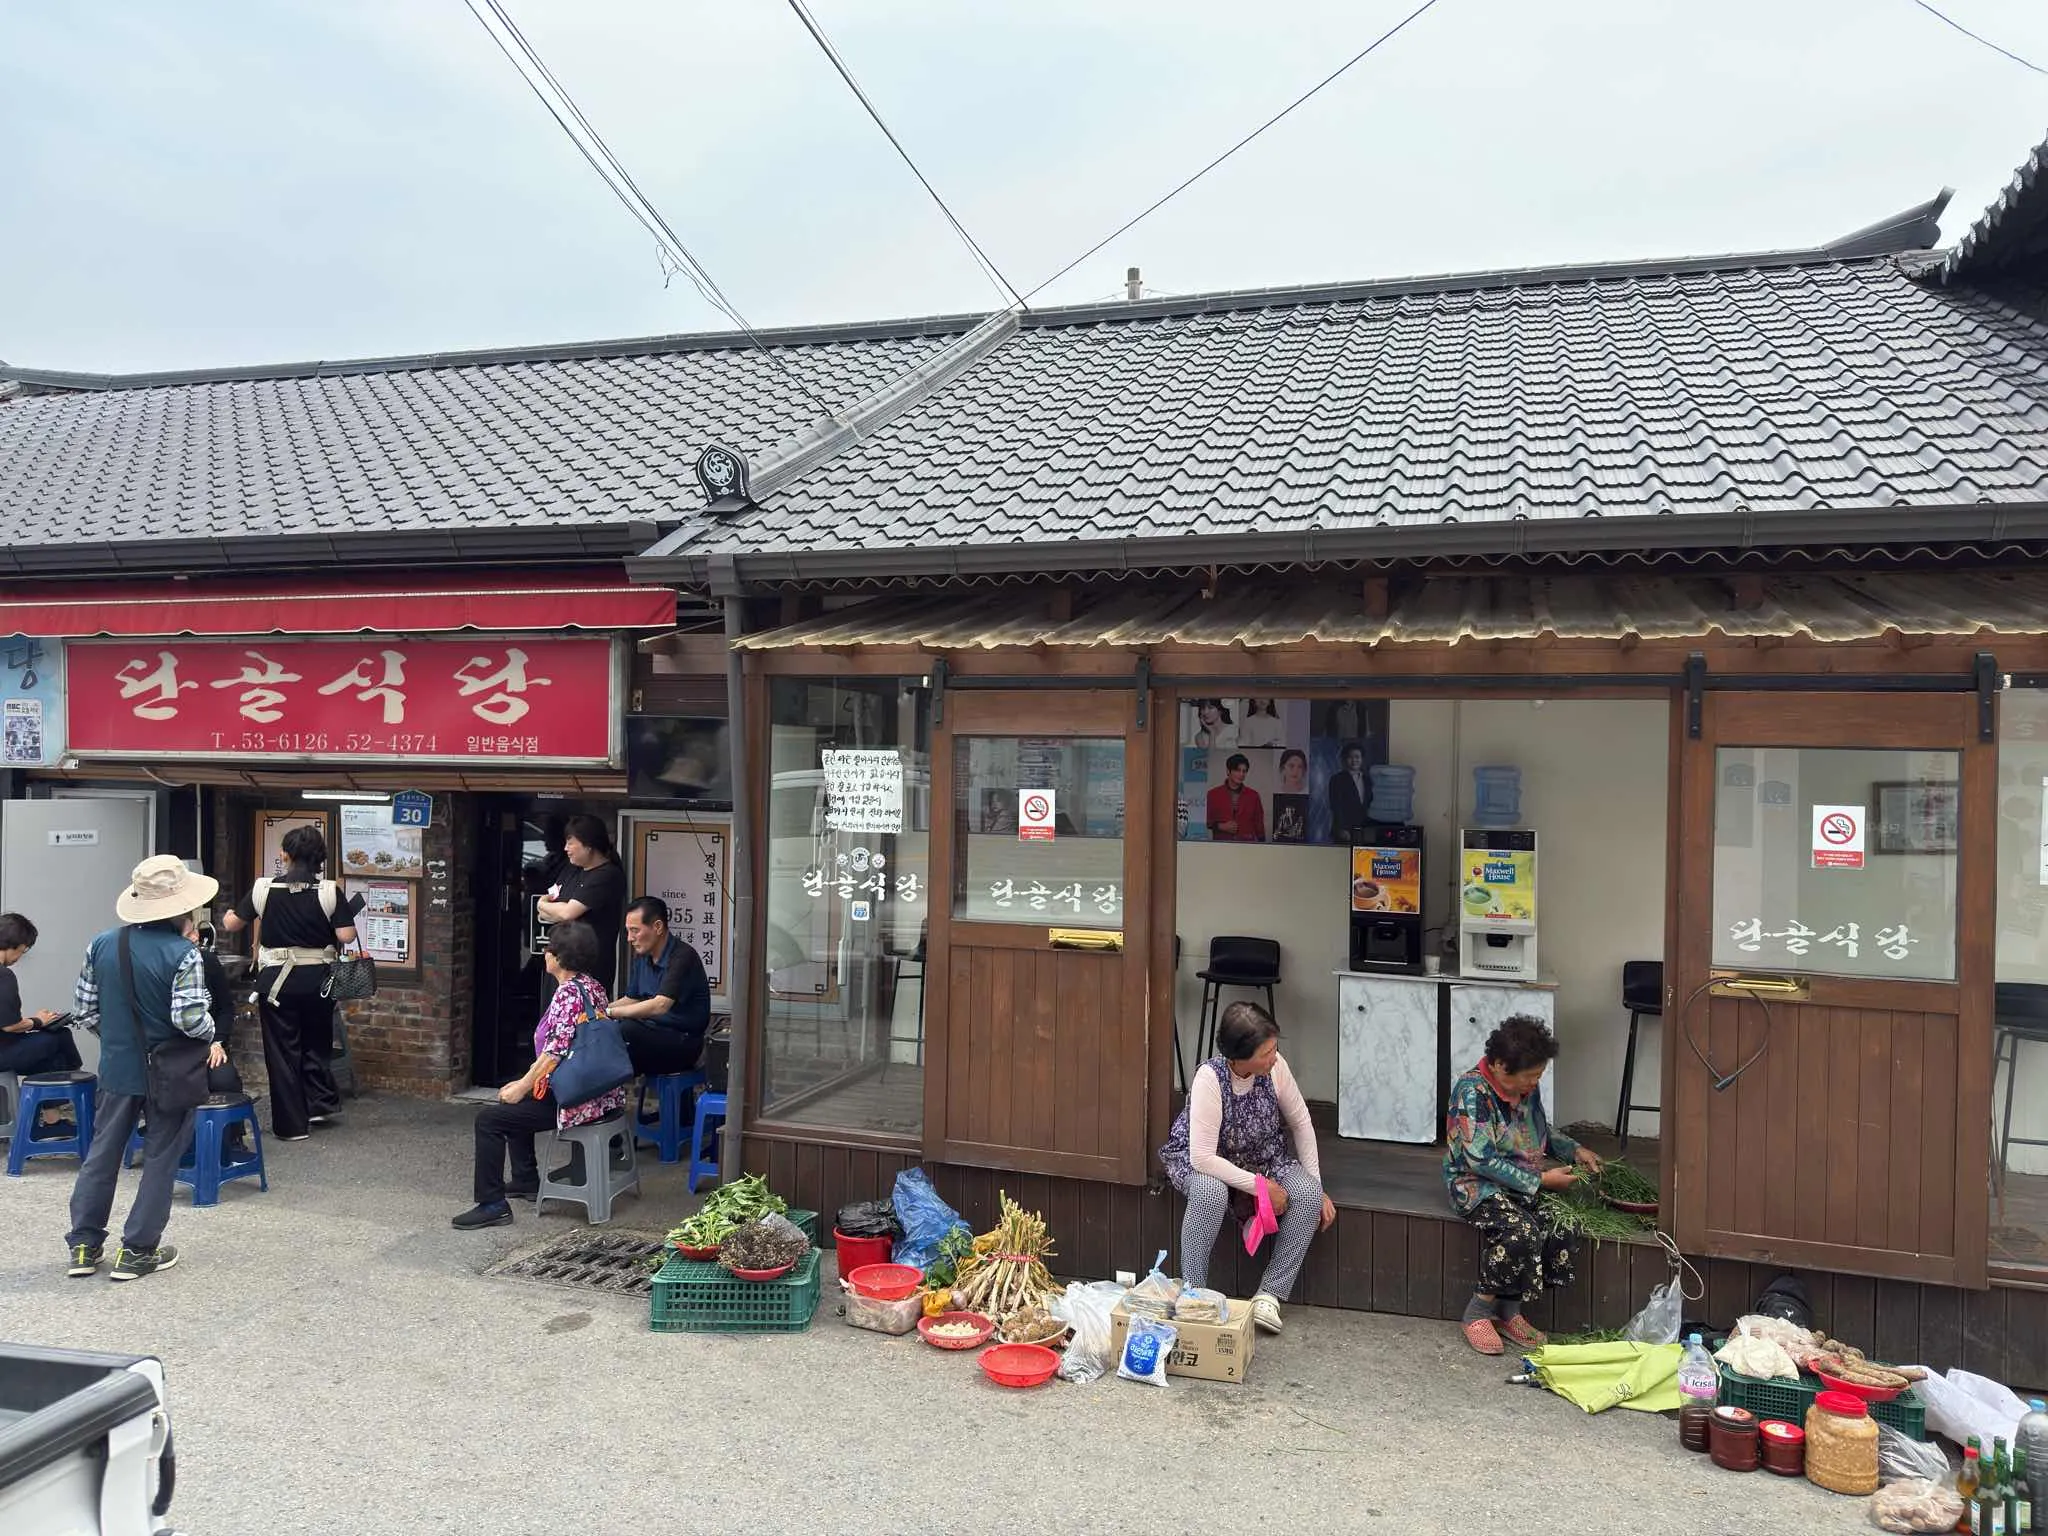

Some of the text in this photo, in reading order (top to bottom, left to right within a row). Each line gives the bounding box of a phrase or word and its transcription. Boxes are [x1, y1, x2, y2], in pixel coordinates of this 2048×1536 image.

[115, 648, 552, 724] 단골식당
[467, 735, 539, 753] 일반음식점
[401, 808, 421, 823] 30
[1485, 867, 1514, 875] Maxwell
[662, 890, 686, 899] since
[802, 870, 924, 902] 단골식당
[989, 878, 1123, 914] 단골식당
[667, 908, 693, 924] 955
[1730, 917, 1919, 960] 단골식당
[1228, 1367, 1234, 1376] 2
